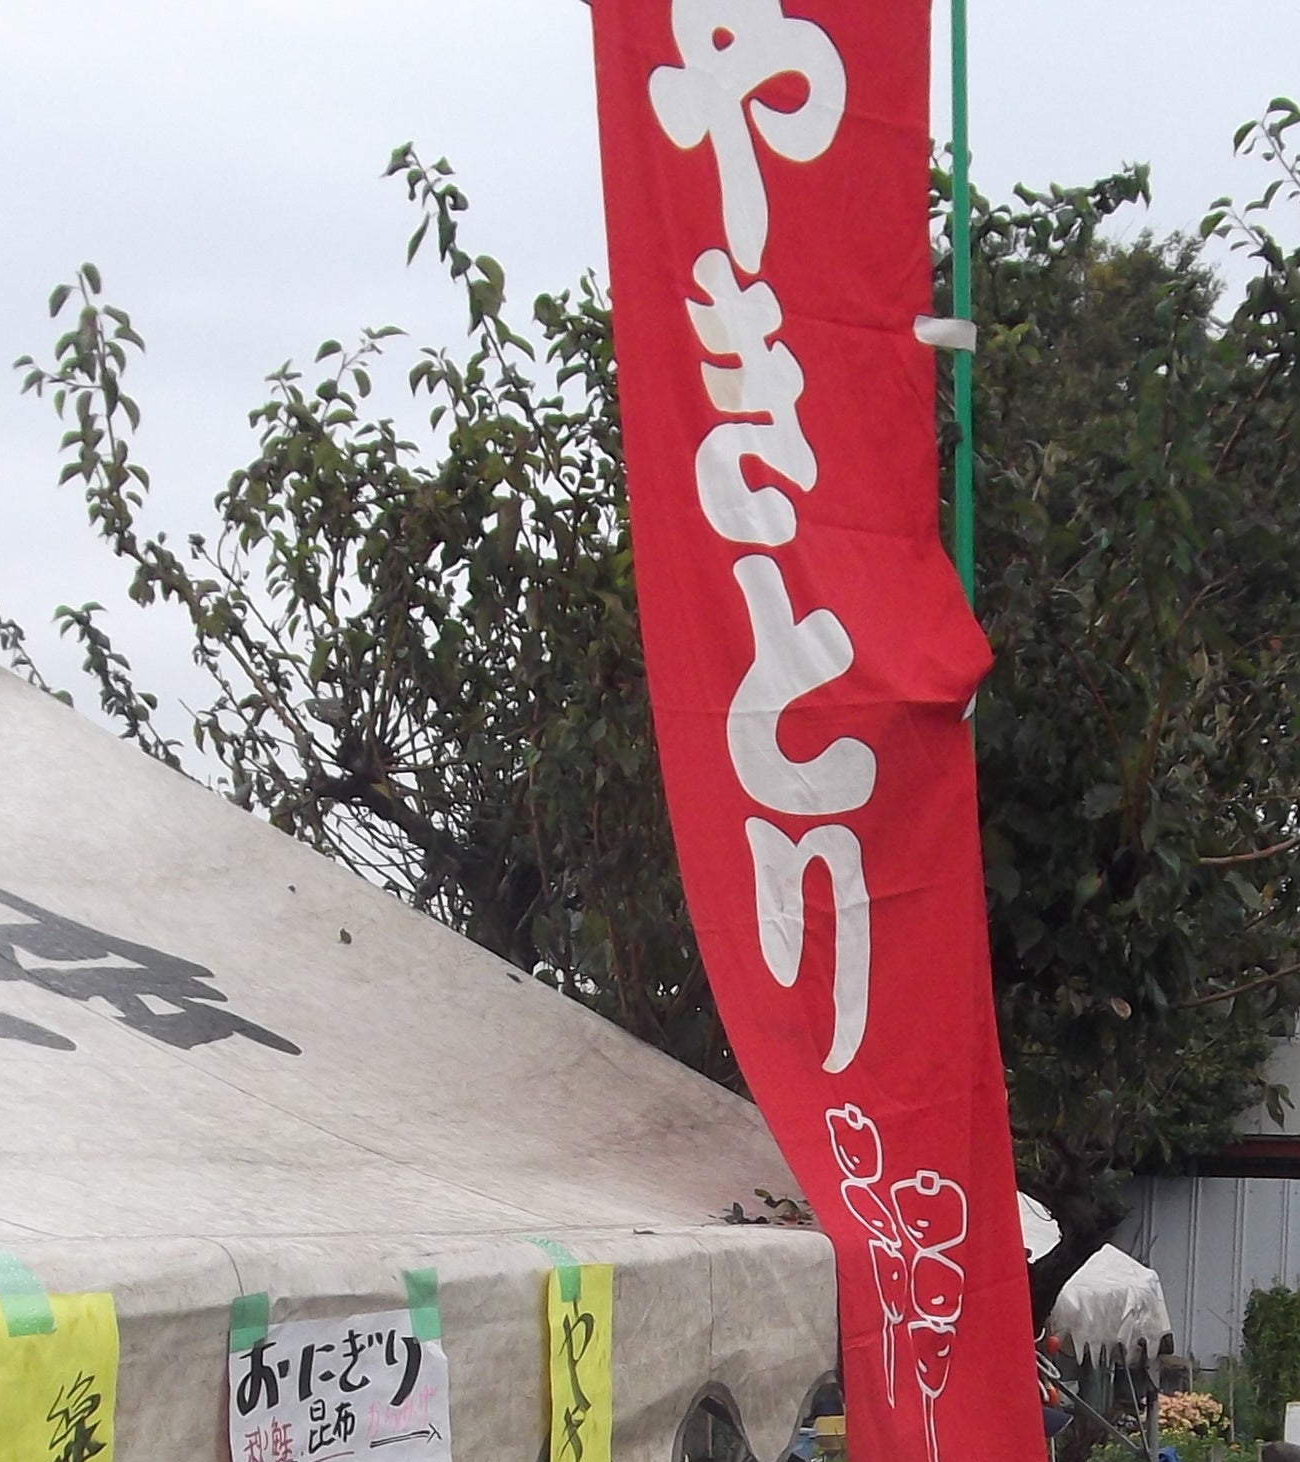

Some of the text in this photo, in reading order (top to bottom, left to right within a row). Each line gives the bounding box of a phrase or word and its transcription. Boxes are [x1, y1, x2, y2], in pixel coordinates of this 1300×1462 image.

[648, 0, 878, 1073] やきとり
[236, 1328, 423, 1417] おにぎり
[308, 1398, 356, 1455] 昆布
